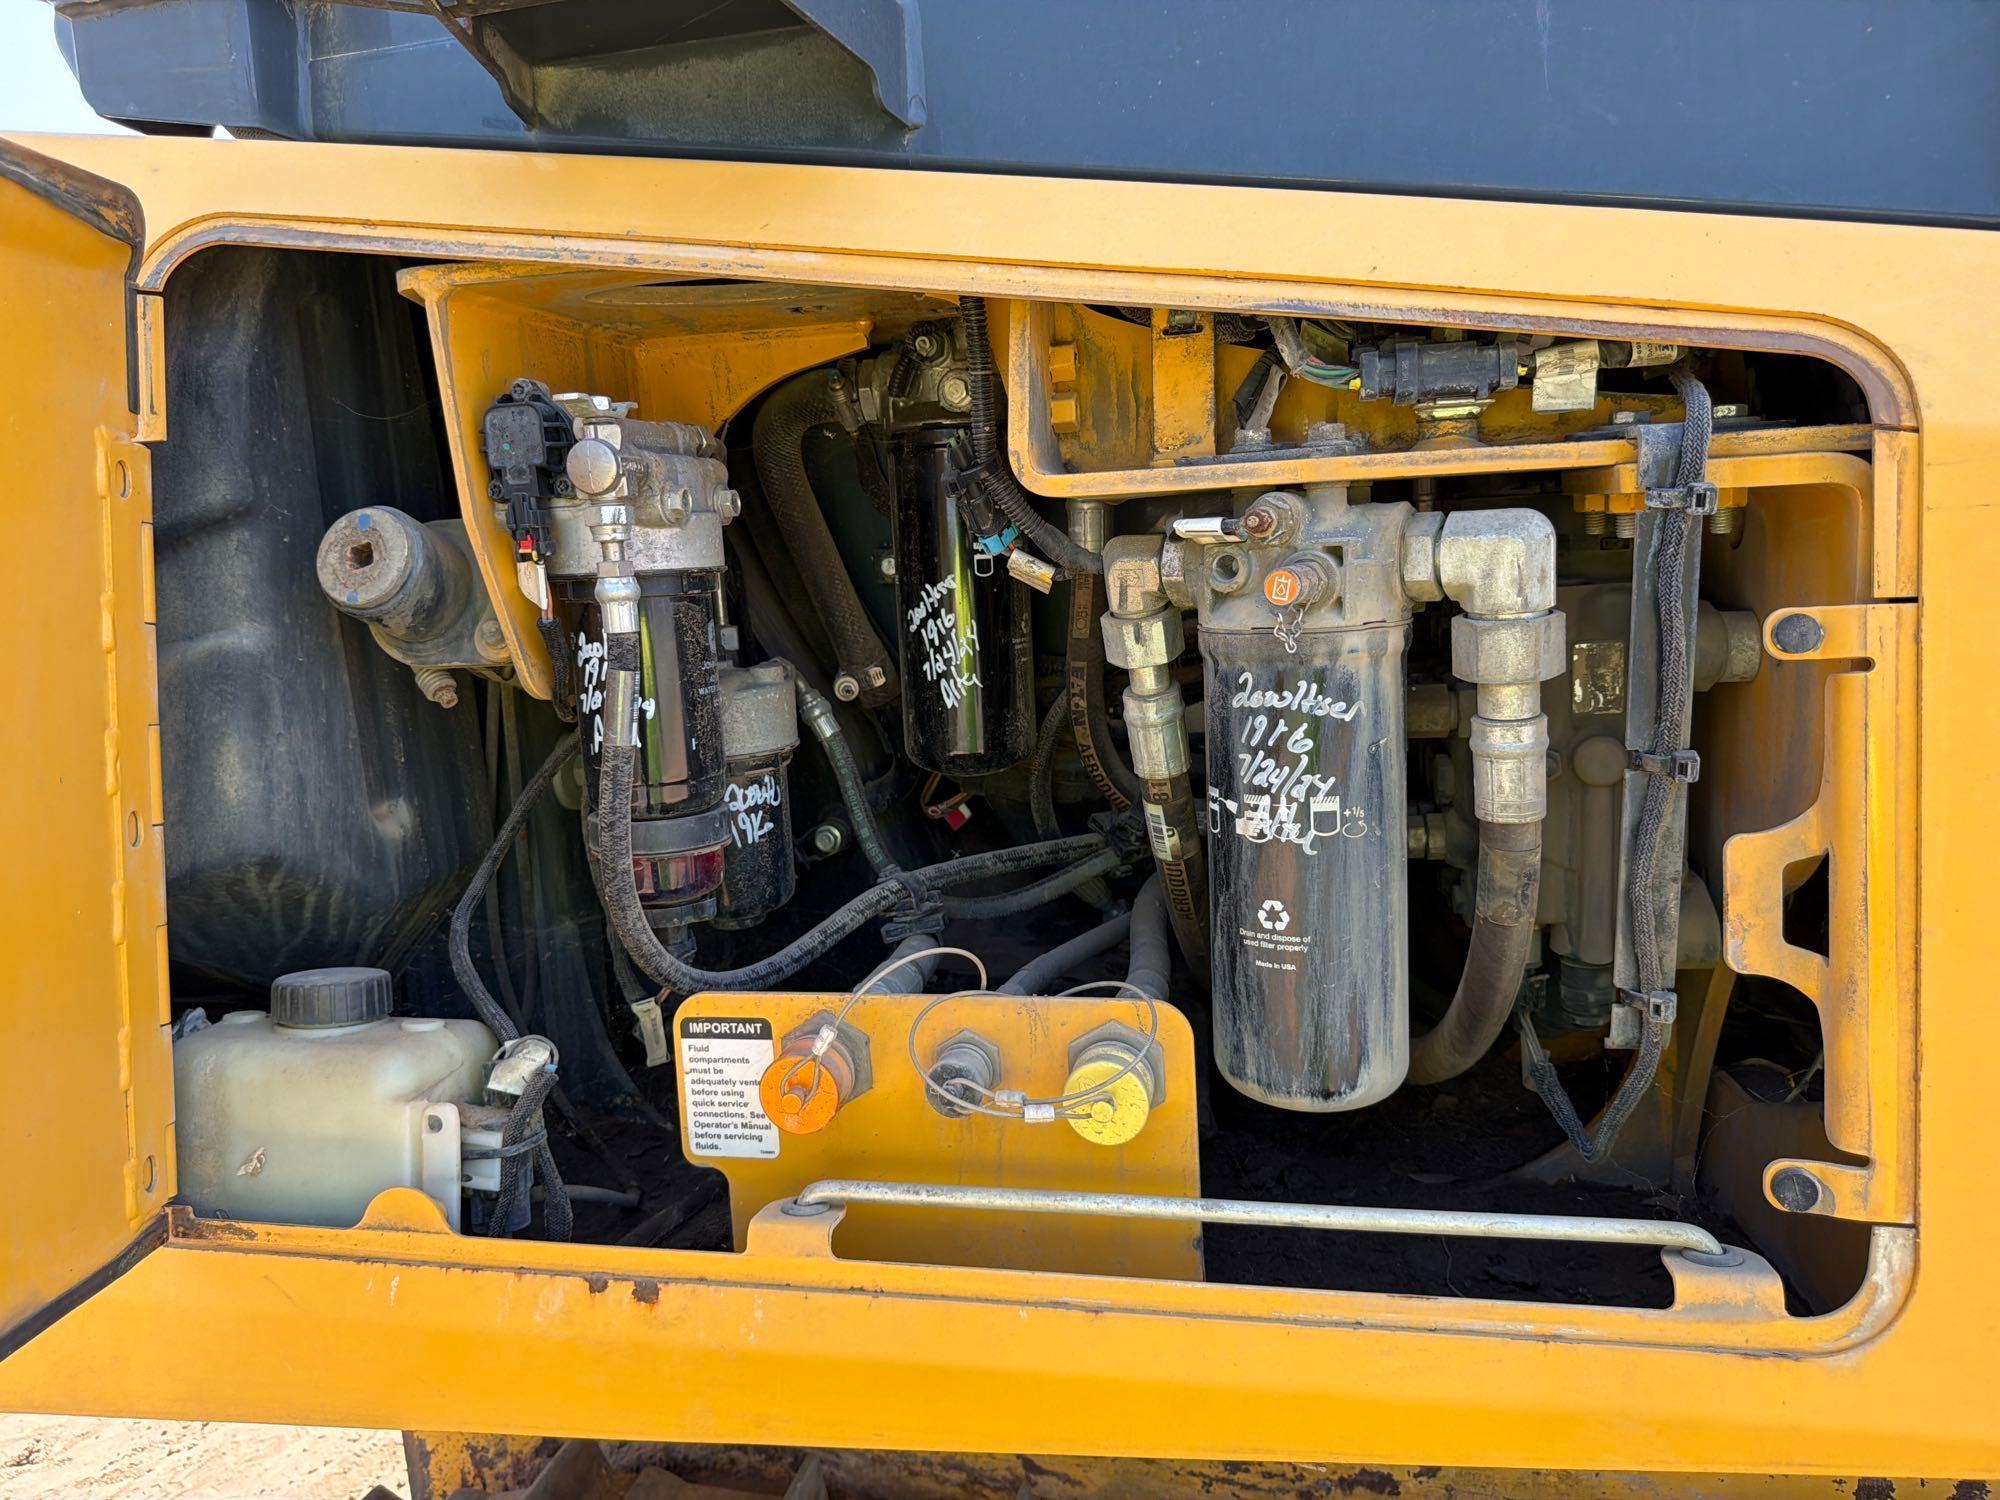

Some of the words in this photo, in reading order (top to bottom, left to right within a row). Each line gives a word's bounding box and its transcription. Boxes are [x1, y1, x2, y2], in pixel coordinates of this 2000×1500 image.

[1238, 750, 1336, 802] 7/24/24
[1239, 927, 1256, 938] Drain
[1256, 932, 1270, 940] and
[1271, 934, 1301, 943] dispose
[1302, 935, 1311, 943] of
[1243, 938, 1259, 947] used
[1260, 940, 1275, 949] filter
[1276, 944, 1309, 953] properly
[1255, 959, 1273, 968] Made
[1281, 963, 1297, 971] USA
[688, 1022, 763, 1034] IMPORTANT
[688, 1044, 710, 1053] Fluid
[688, 1056, 750, 1065] compartments
[713, 1067, 724, 1075] be
[690, 1078, 737, 1087] adequately
[691, 1088, 718, 1096] before
[721, 1089, 745, 1098] using
[692, 1099, 715, 1108] quick
[717, 1100, 749, 1108] service
[693, 1110, 748, 1119] connections.
[750, 1111, 766, 1119] See
[693, 1120, 738, 1130] Operator's
[741, 1122, 772, 1130] Manual
[694, 1131, 722, 1140] before
[724, 1133, 763, 1142] servicing
[695, 1142, 722, 1150] fluids.
